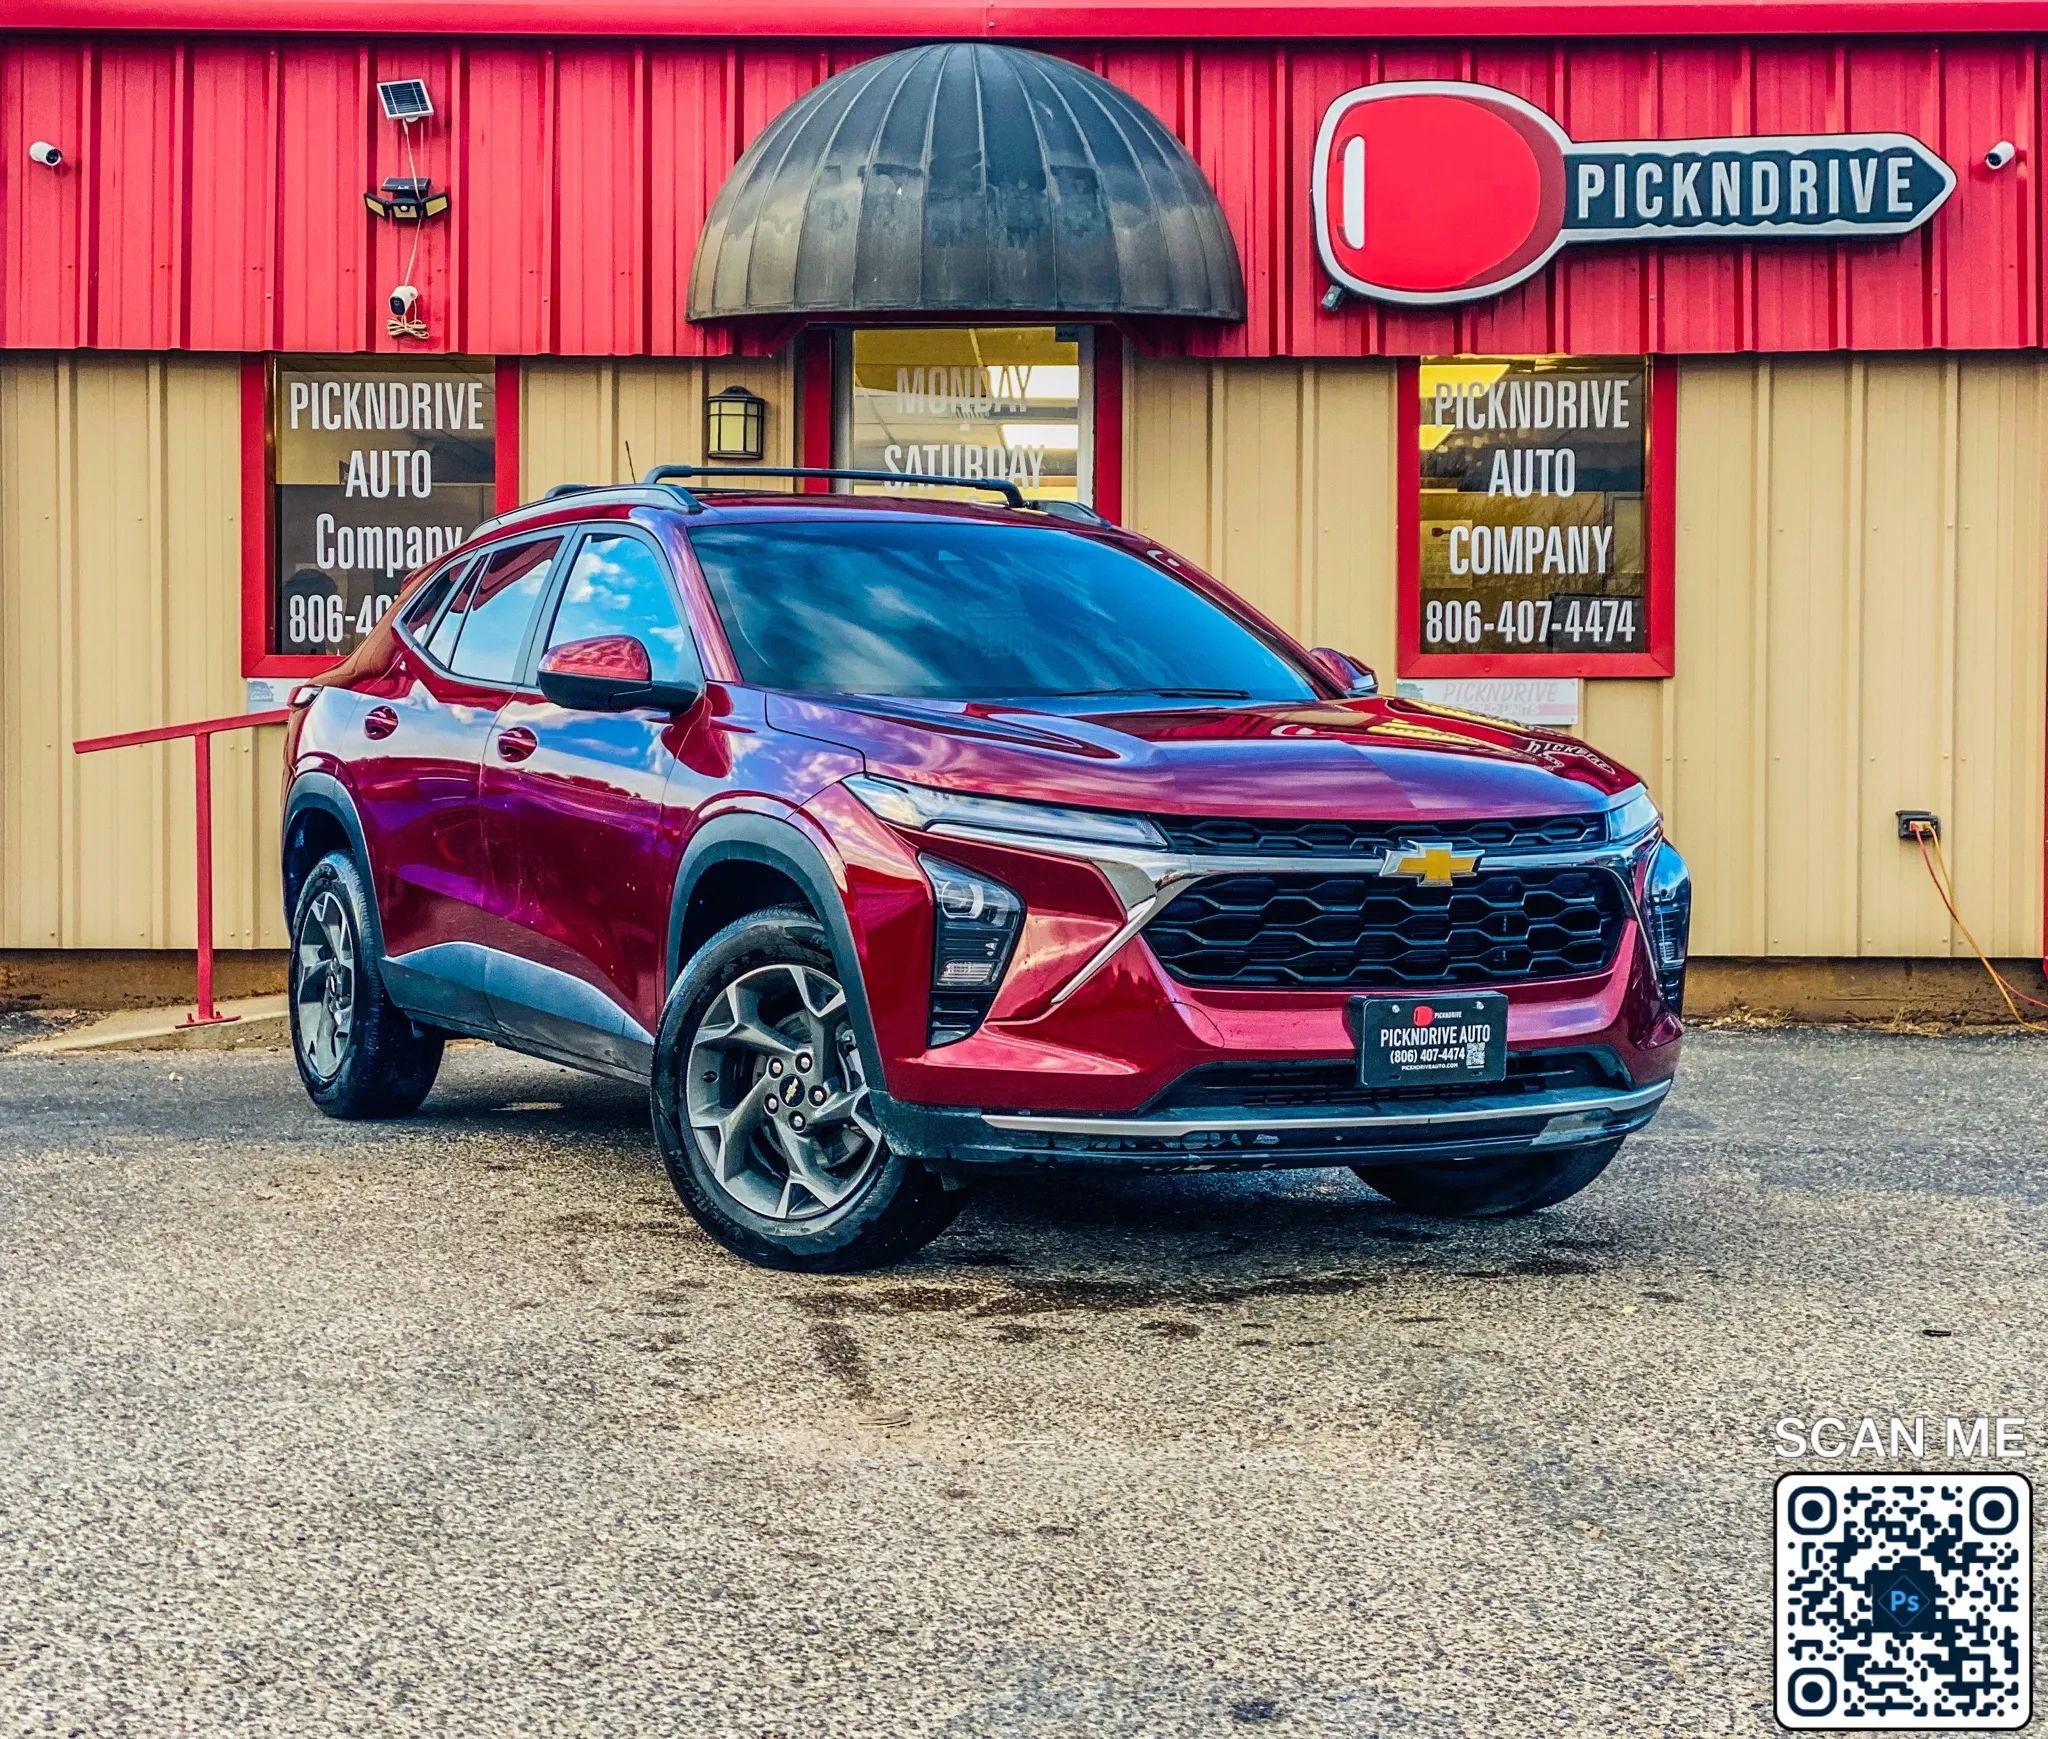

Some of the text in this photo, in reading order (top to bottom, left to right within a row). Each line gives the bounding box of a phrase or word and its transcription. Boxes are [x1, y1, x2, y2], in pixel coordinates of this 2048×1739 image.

[1579, 156, 1914, 219] PICKNDRIVE
[290, 381, 484, 430] PICKNDRIVE
[896, 366, 1032, 414] MONDAY
[1434, 380, 1630, 429] PICKNDRIVE
[345, 449, 432, 498] AUTO
[884, 444, 1045, 490] SATURDAY
[1488, 448, 1576, 498] AUTO
[1450, 525, 1613, 576] COMPANY
[289, 594, 401, 642] 806-40
[1426, 600, 1636, 644] 806-407-4474
[1442, 681, 1560, 703] PICKNDRIVE
[1380, 1024, 1491, 1048] PICKNDRIVE AUTO
[1434, 1011, 1462, 1019] PICKNDRIVE
[1390, 1047, 1466, 1064] (806) 407-4474
[1401, 1063, 1458, 1071] PICKNDRIVEAUTO.COM
